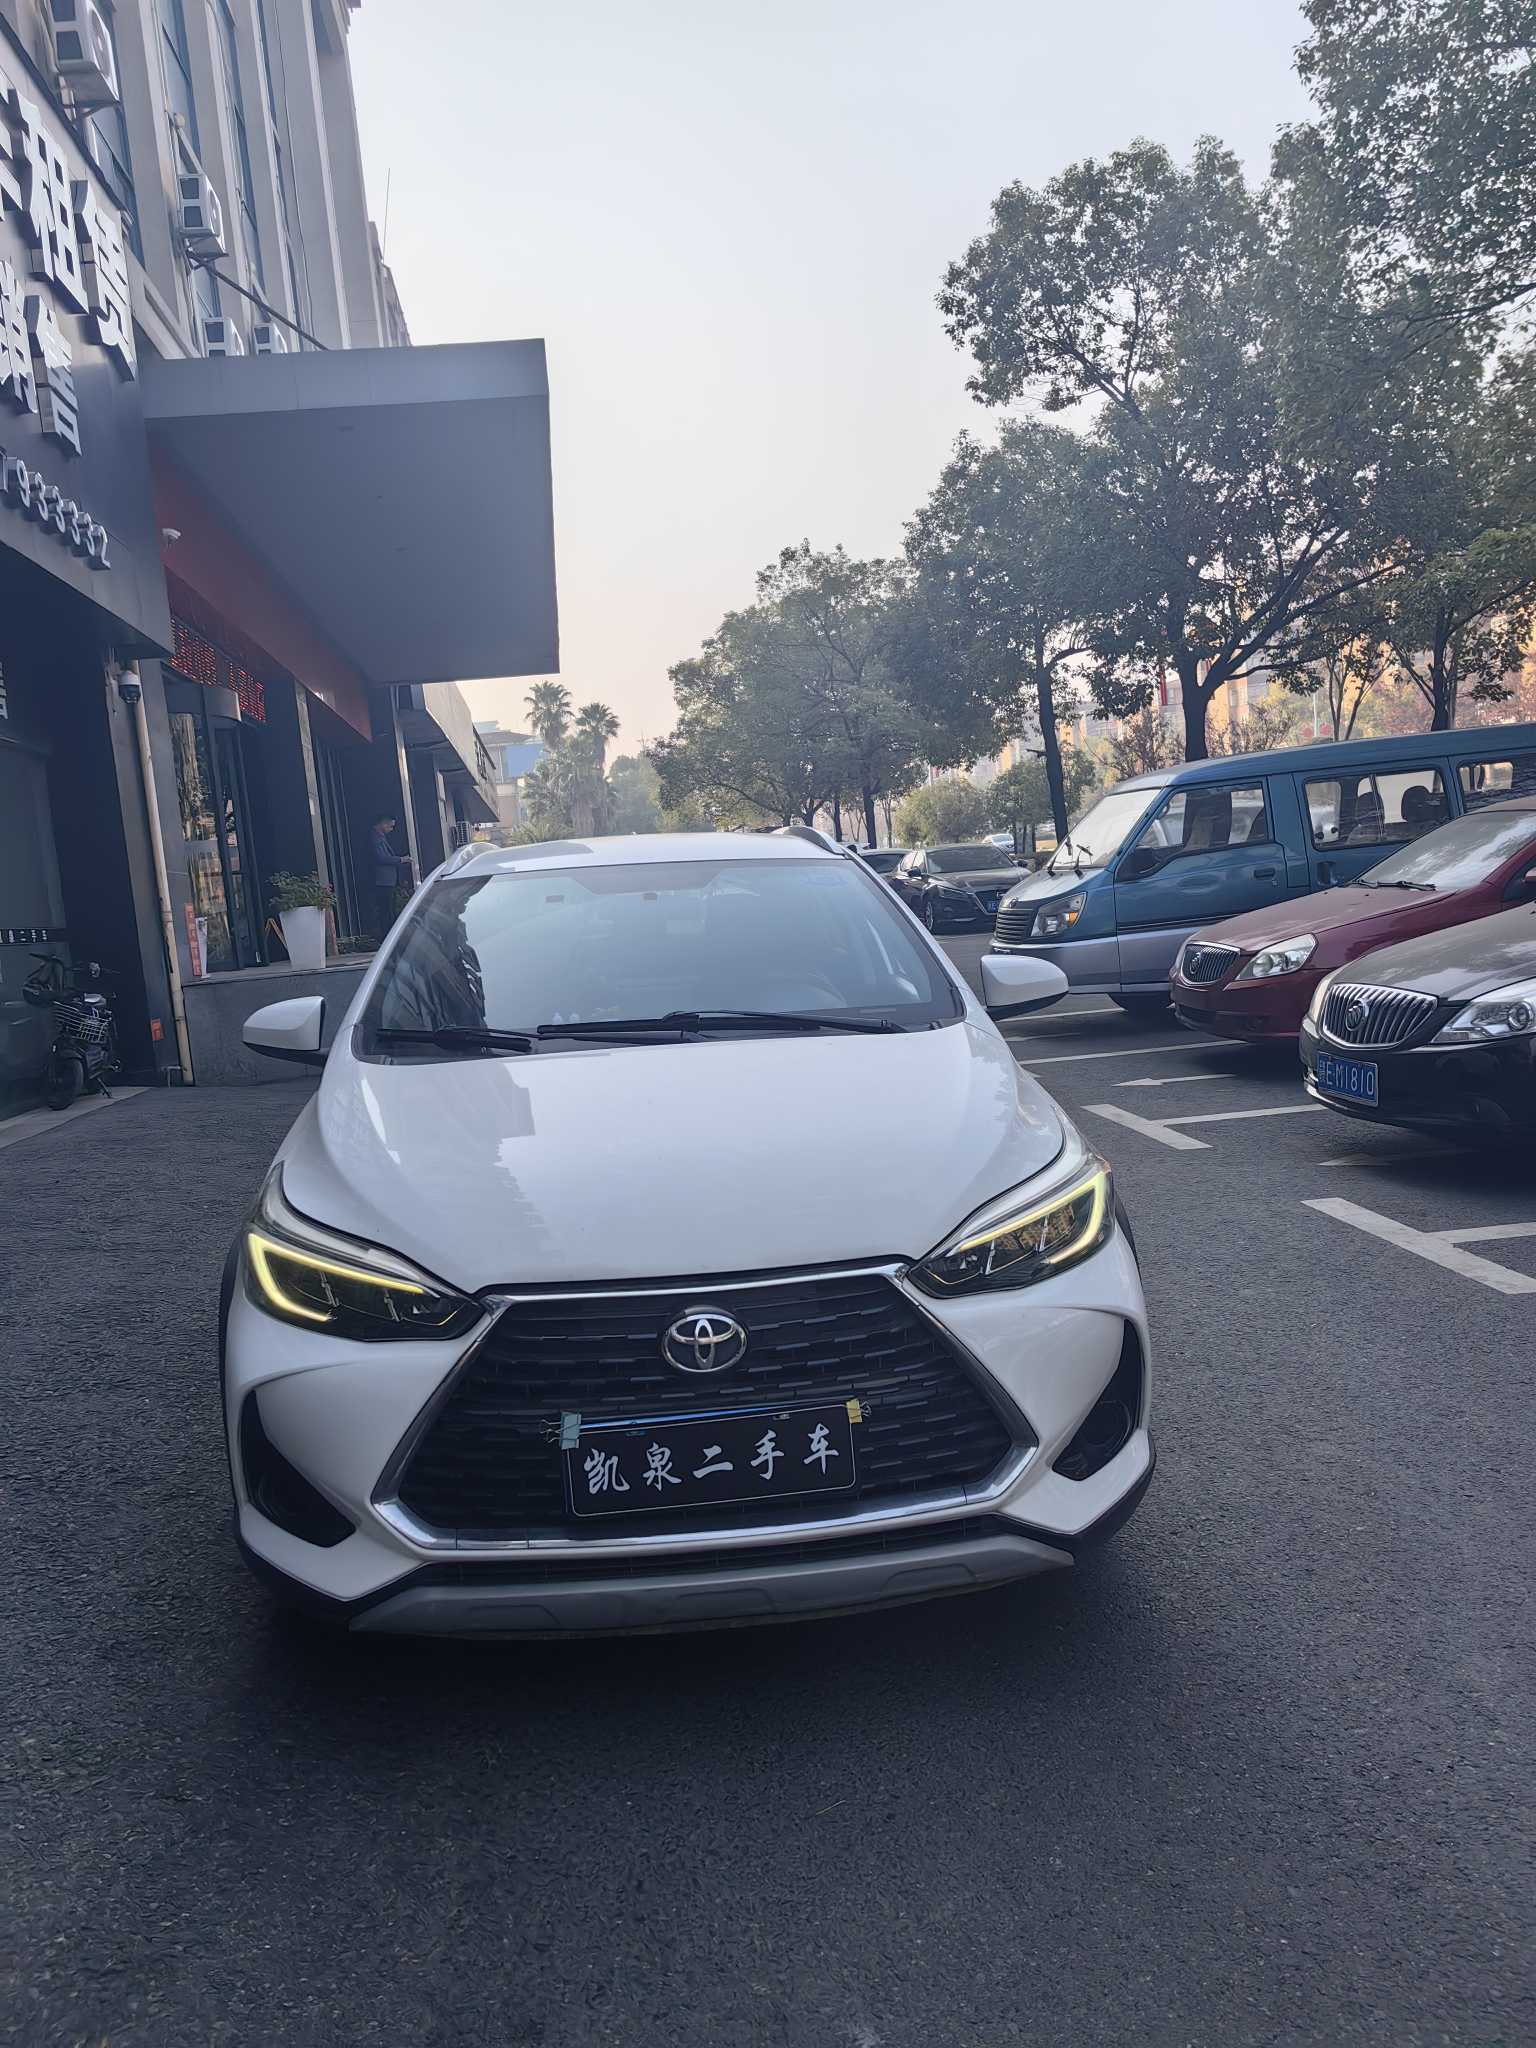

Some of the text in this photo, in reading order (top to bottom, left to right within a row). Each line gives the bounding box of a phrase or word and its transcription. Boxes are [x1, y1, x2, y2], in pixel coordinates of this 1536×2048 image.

[584, 1423, 839, 1495] 凯泉二手车
